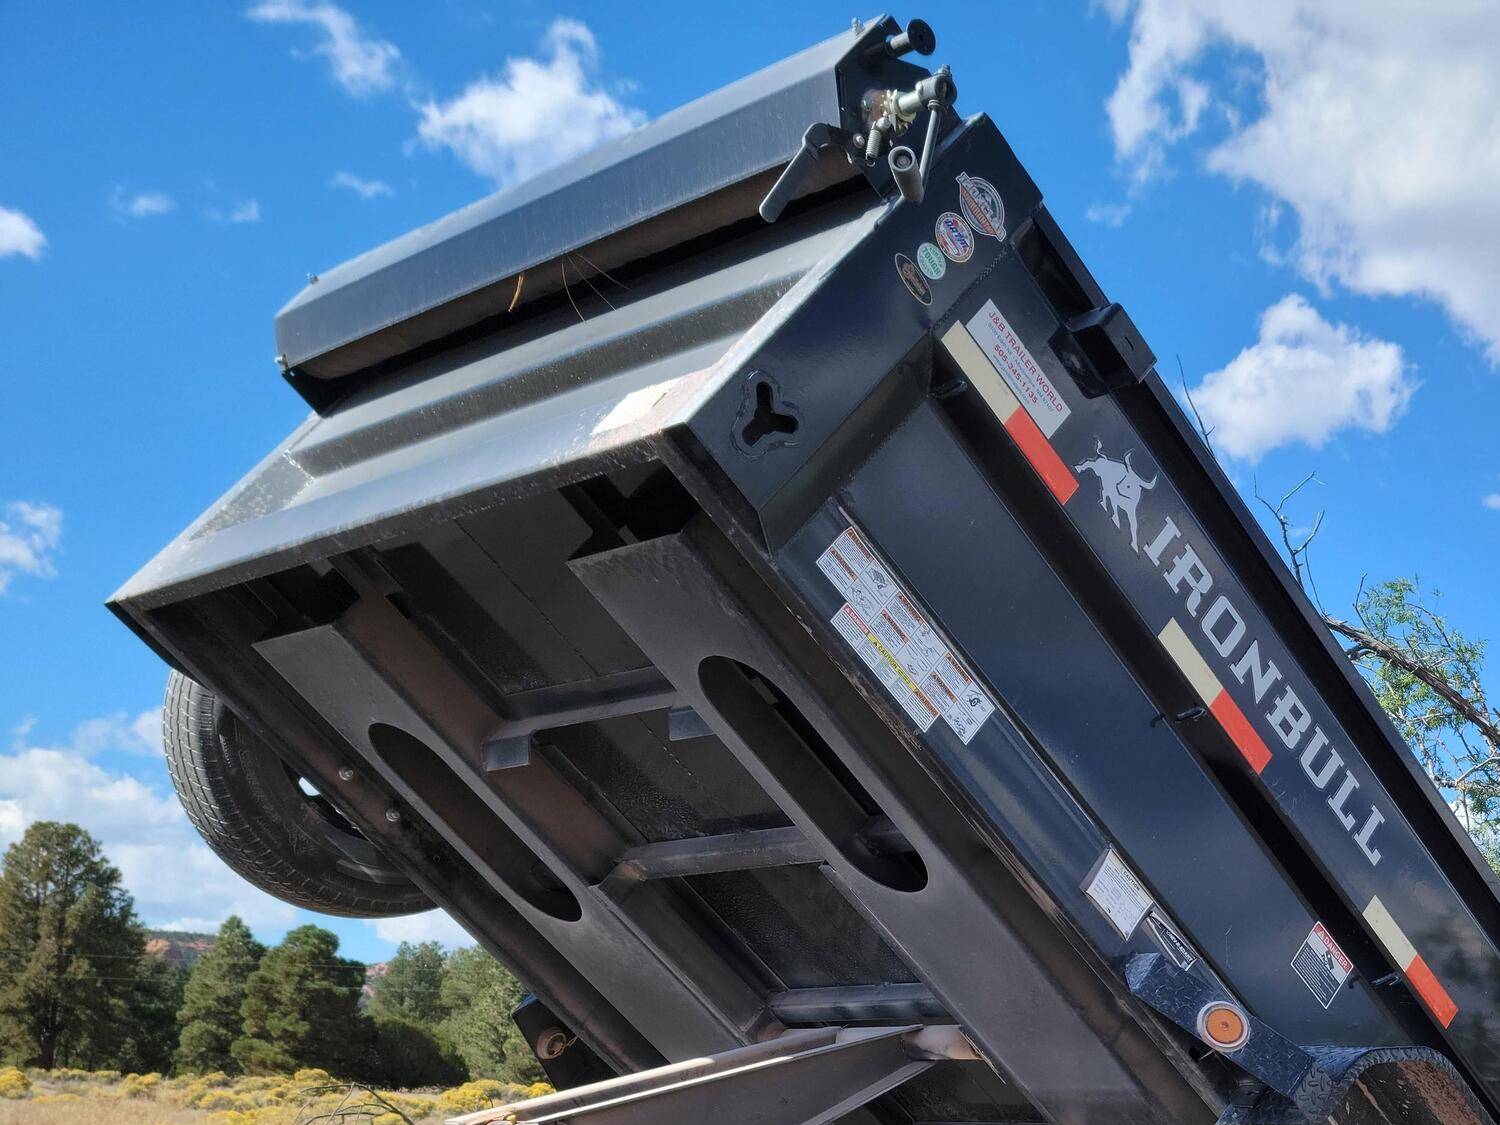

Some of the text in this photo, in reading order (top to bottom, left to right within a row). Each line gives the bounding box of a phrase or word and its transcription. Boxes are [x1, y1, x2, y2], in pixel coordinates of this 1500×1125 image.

[923, 247, 941, 275] TOUGH
[988, 312, 1005, 332] J&B
[1005, 332, 1037, 374] TRAILER
[1036, 369, 1063, 412] WORLD
[878, 644, 898, 670] CAUTION
[1143, 516, 1385, 866] IRONBULL
[1124, 871, 1140, 891] CAUTION
[1324, 937, 1348, 968] DANGER
